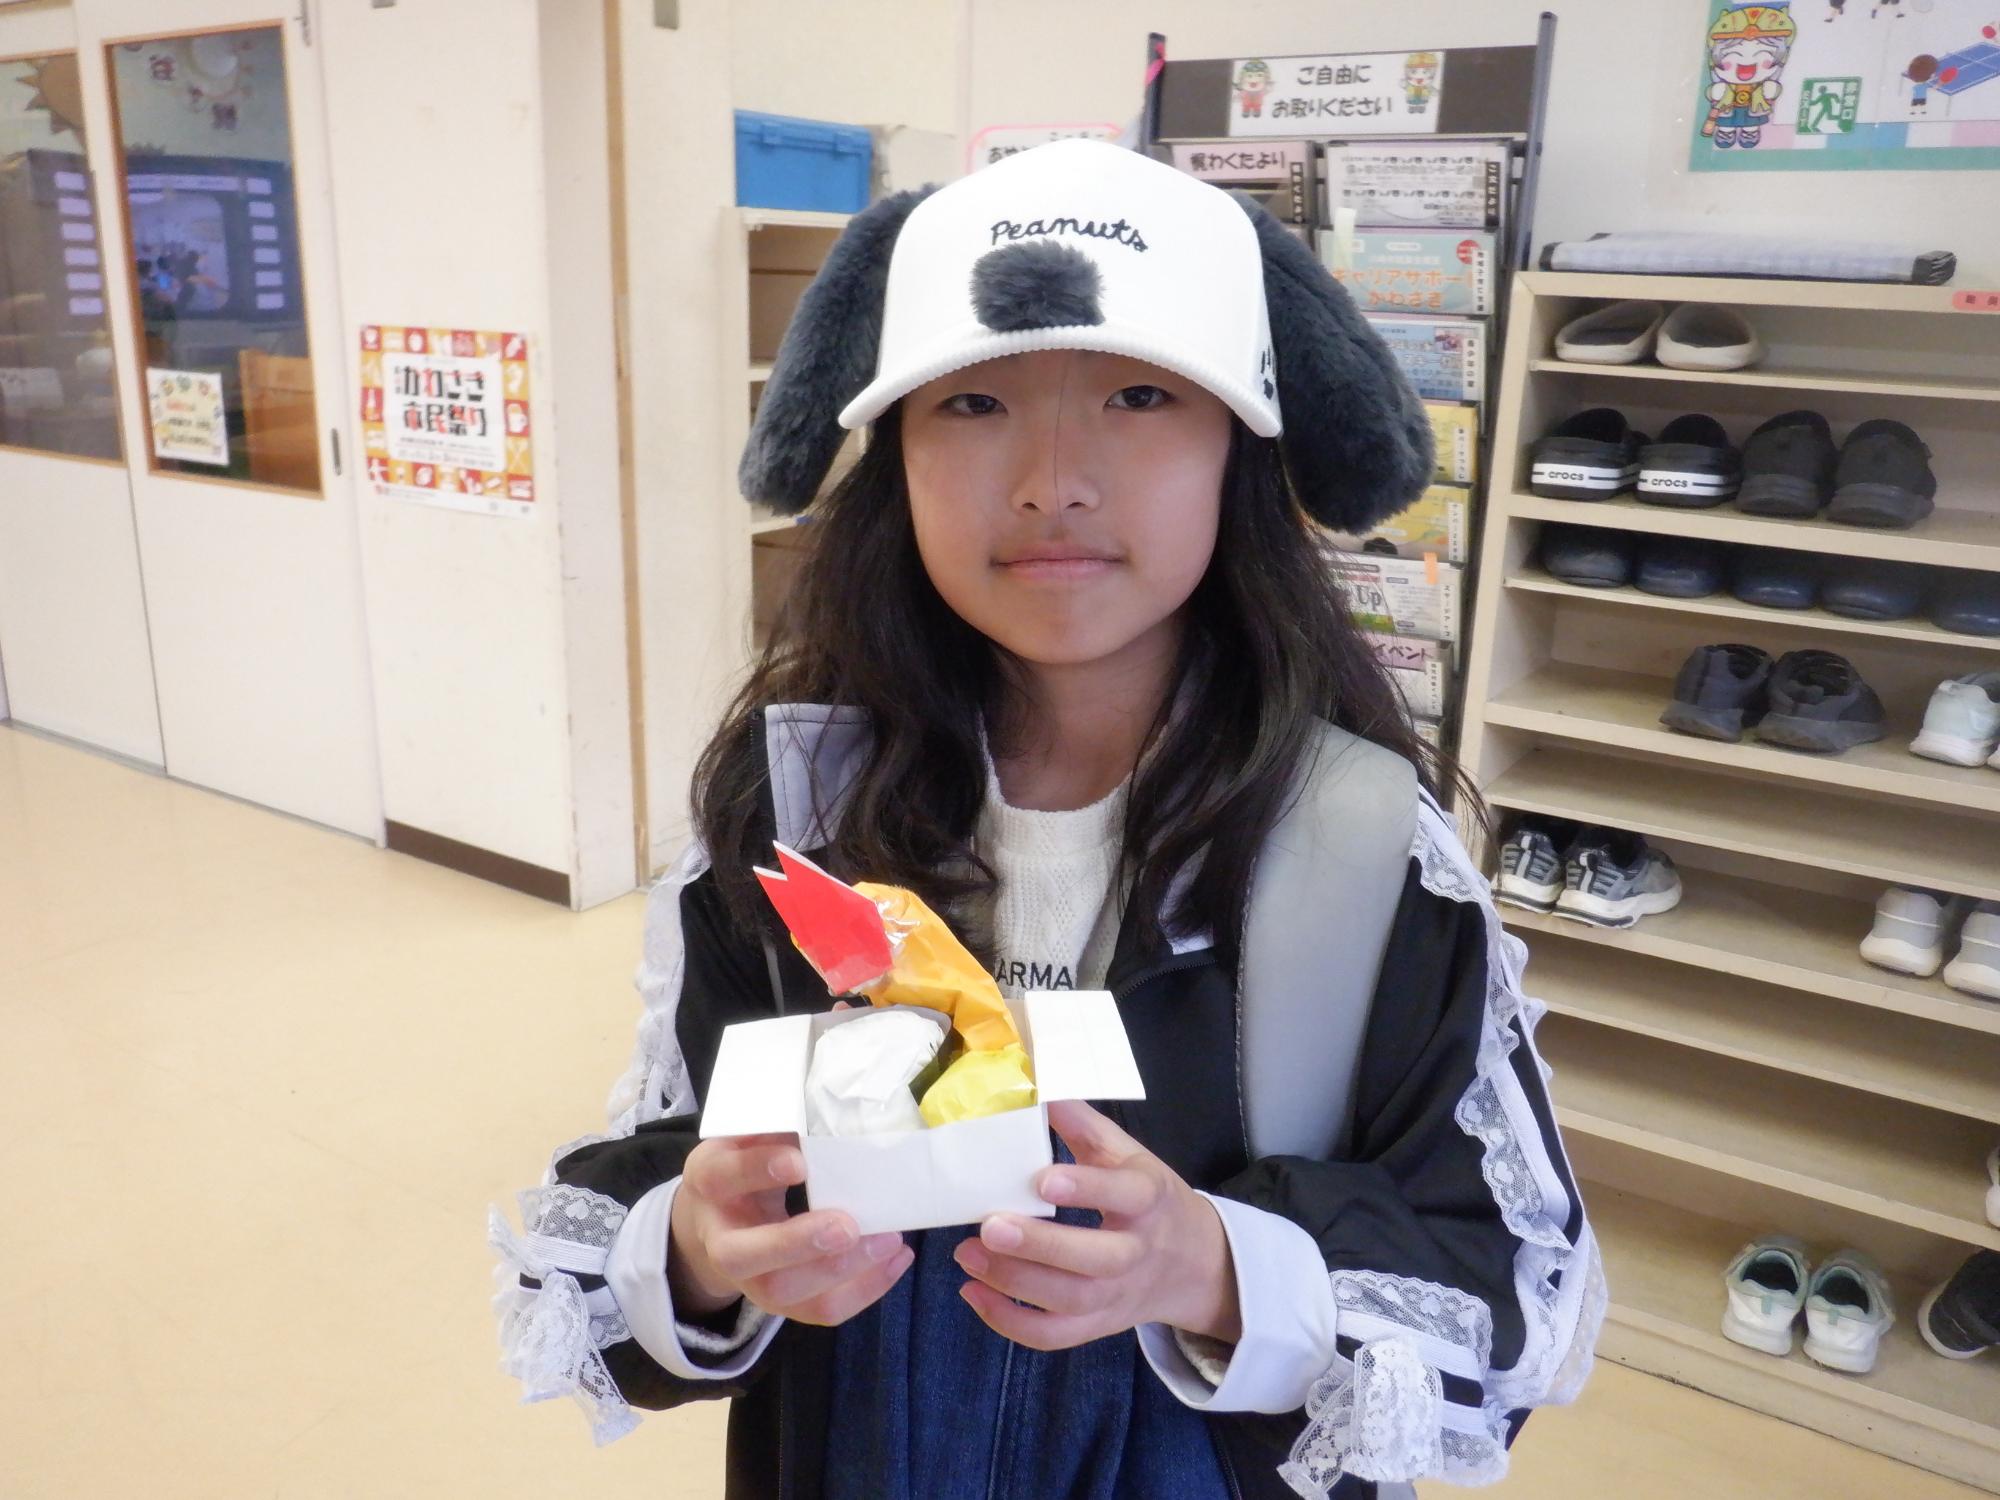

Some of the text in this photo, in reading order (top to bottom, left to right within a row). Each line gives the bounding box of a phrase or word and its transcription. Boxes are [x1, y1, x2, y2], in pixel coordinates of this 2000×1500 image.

[1296, 64, 1372, 86] ご自由に
[1271, 96, 1393, 119] お取りください
[403, 365, 486, 402] かわさき
[402, 400, 488, 437] 市民祭り
[1548, 470, 1585, 481] crocs
[1651, 478, 1688, 488] crocs
